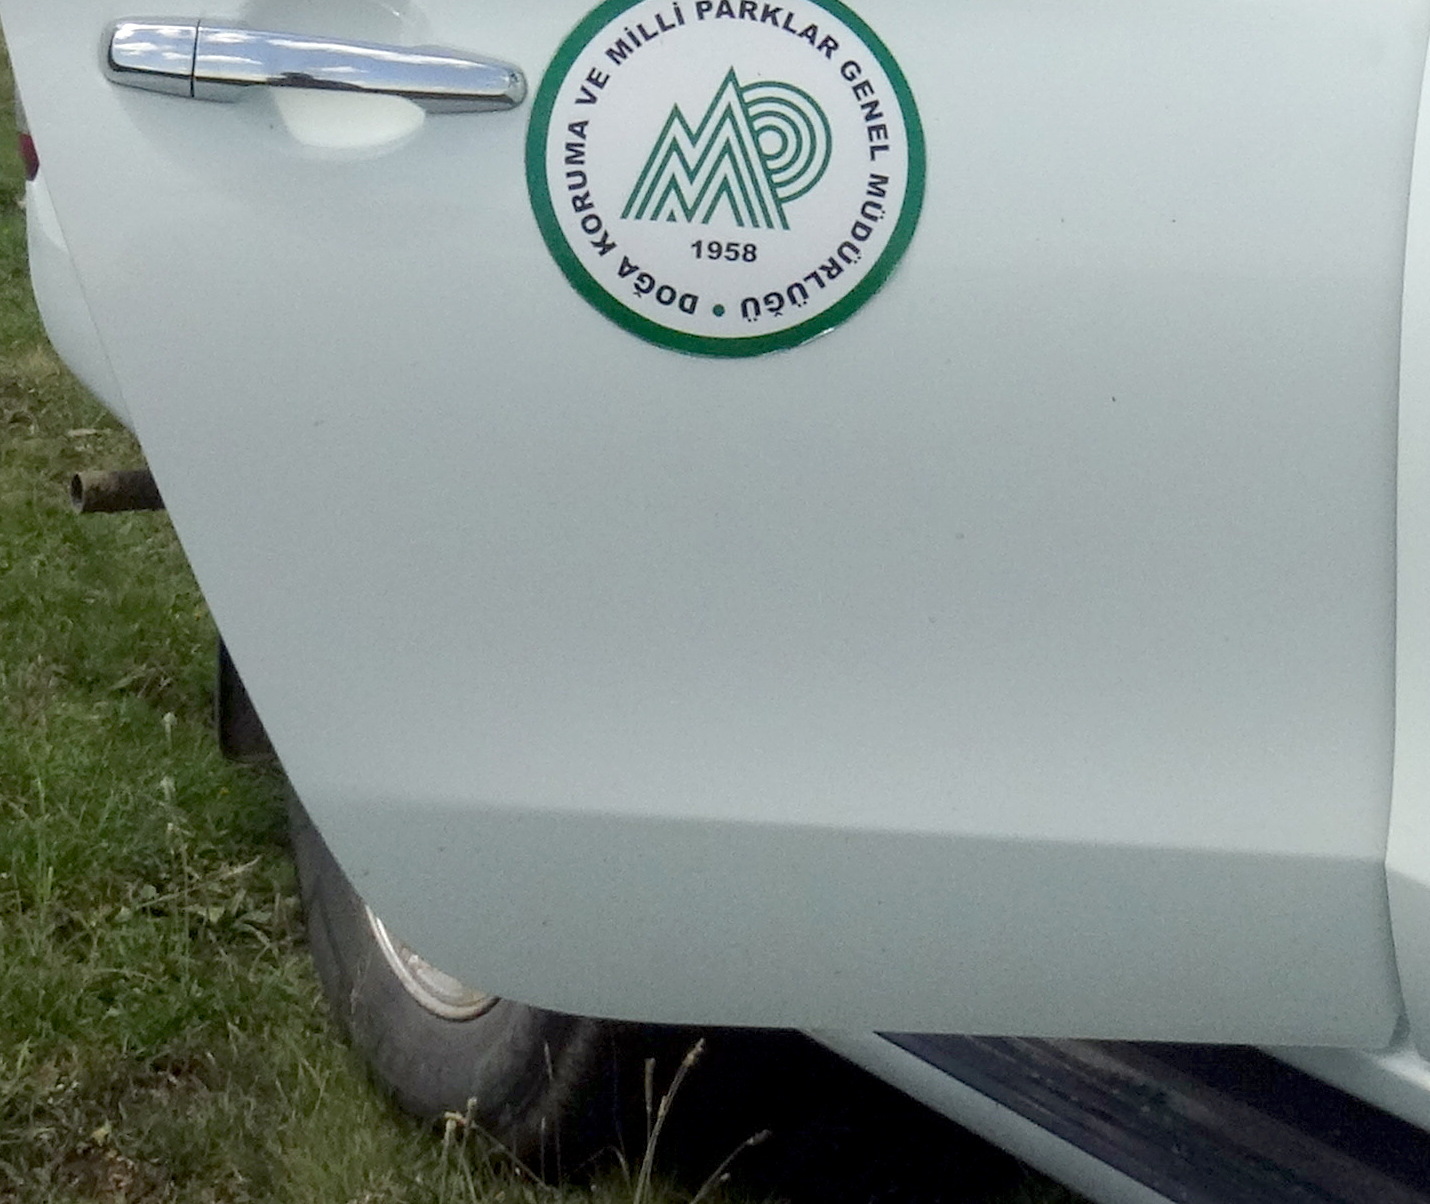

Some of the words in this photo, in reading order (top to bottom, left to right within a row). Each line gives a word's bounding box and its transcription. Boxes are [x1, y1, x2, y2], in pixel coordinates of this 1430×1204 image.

[605, 1, 686, 66] MİLLİ
[575, 67, 609, 106] VE
[839, 59, 890, 162] GENEL
[565, 119, 617, 257] KORUMA
[690, 240, 758, 263] 1958
[740, 173, 889, 323] MÜDÜRLÜĞÜ
[617, 255, 699, 315] DOĞA
